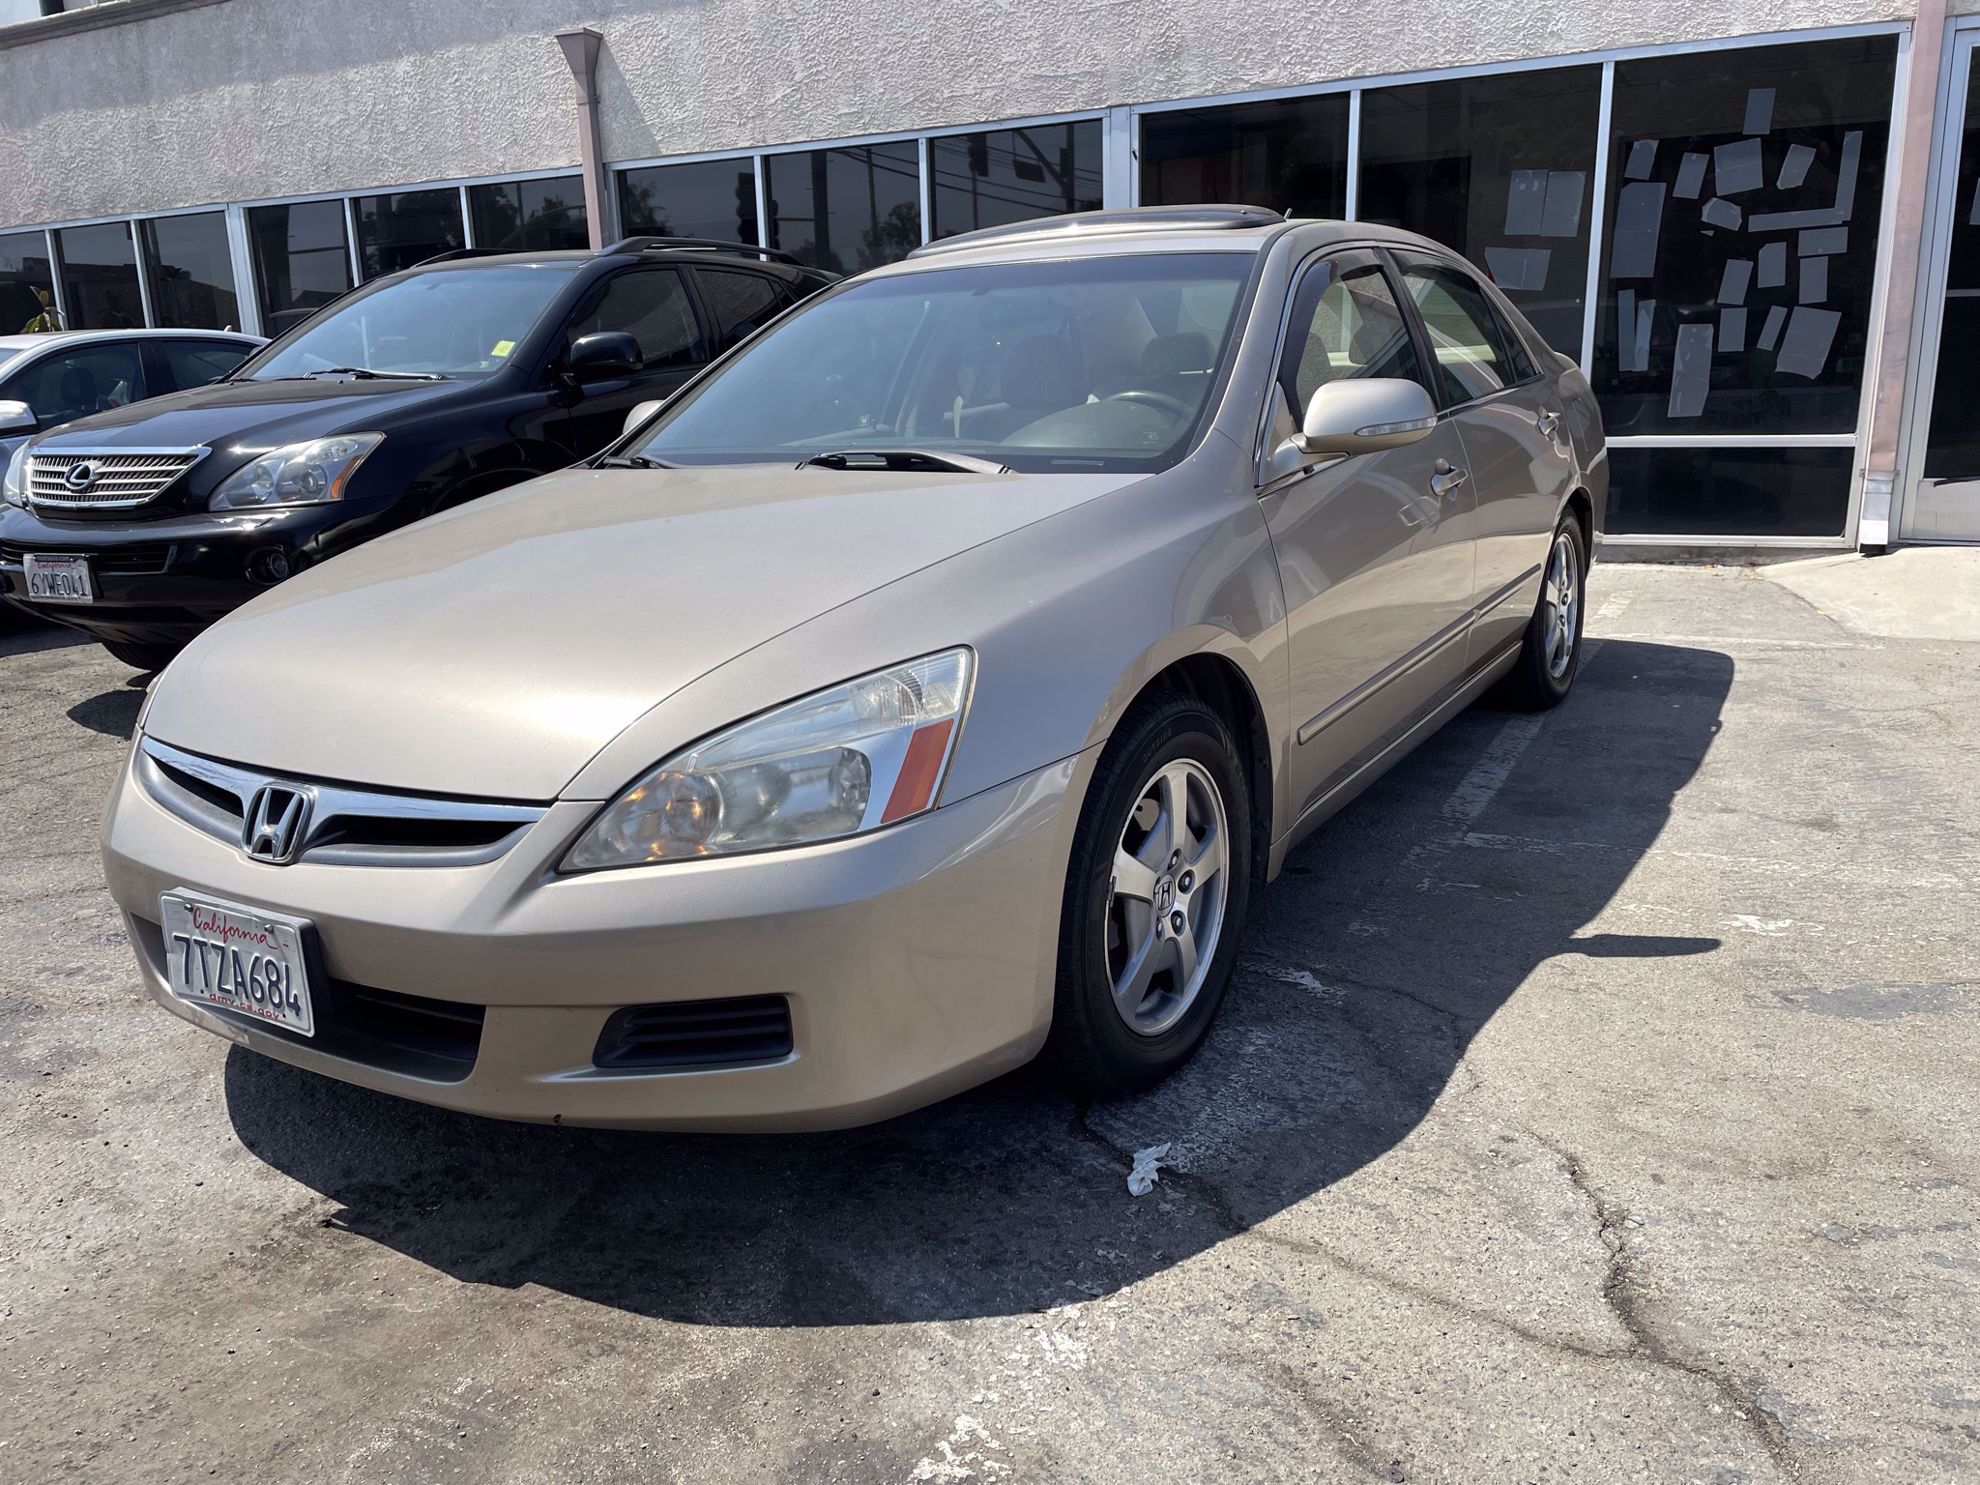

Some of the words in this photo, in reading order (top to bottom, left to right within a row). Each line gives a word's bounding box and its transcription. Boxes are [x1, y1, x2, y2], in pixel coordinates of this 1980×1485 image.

[31, 573, 88, 597] 6YWE041
[192, 906, 278, 950] California
[173, 934, 301, 1017] 7TZA684
